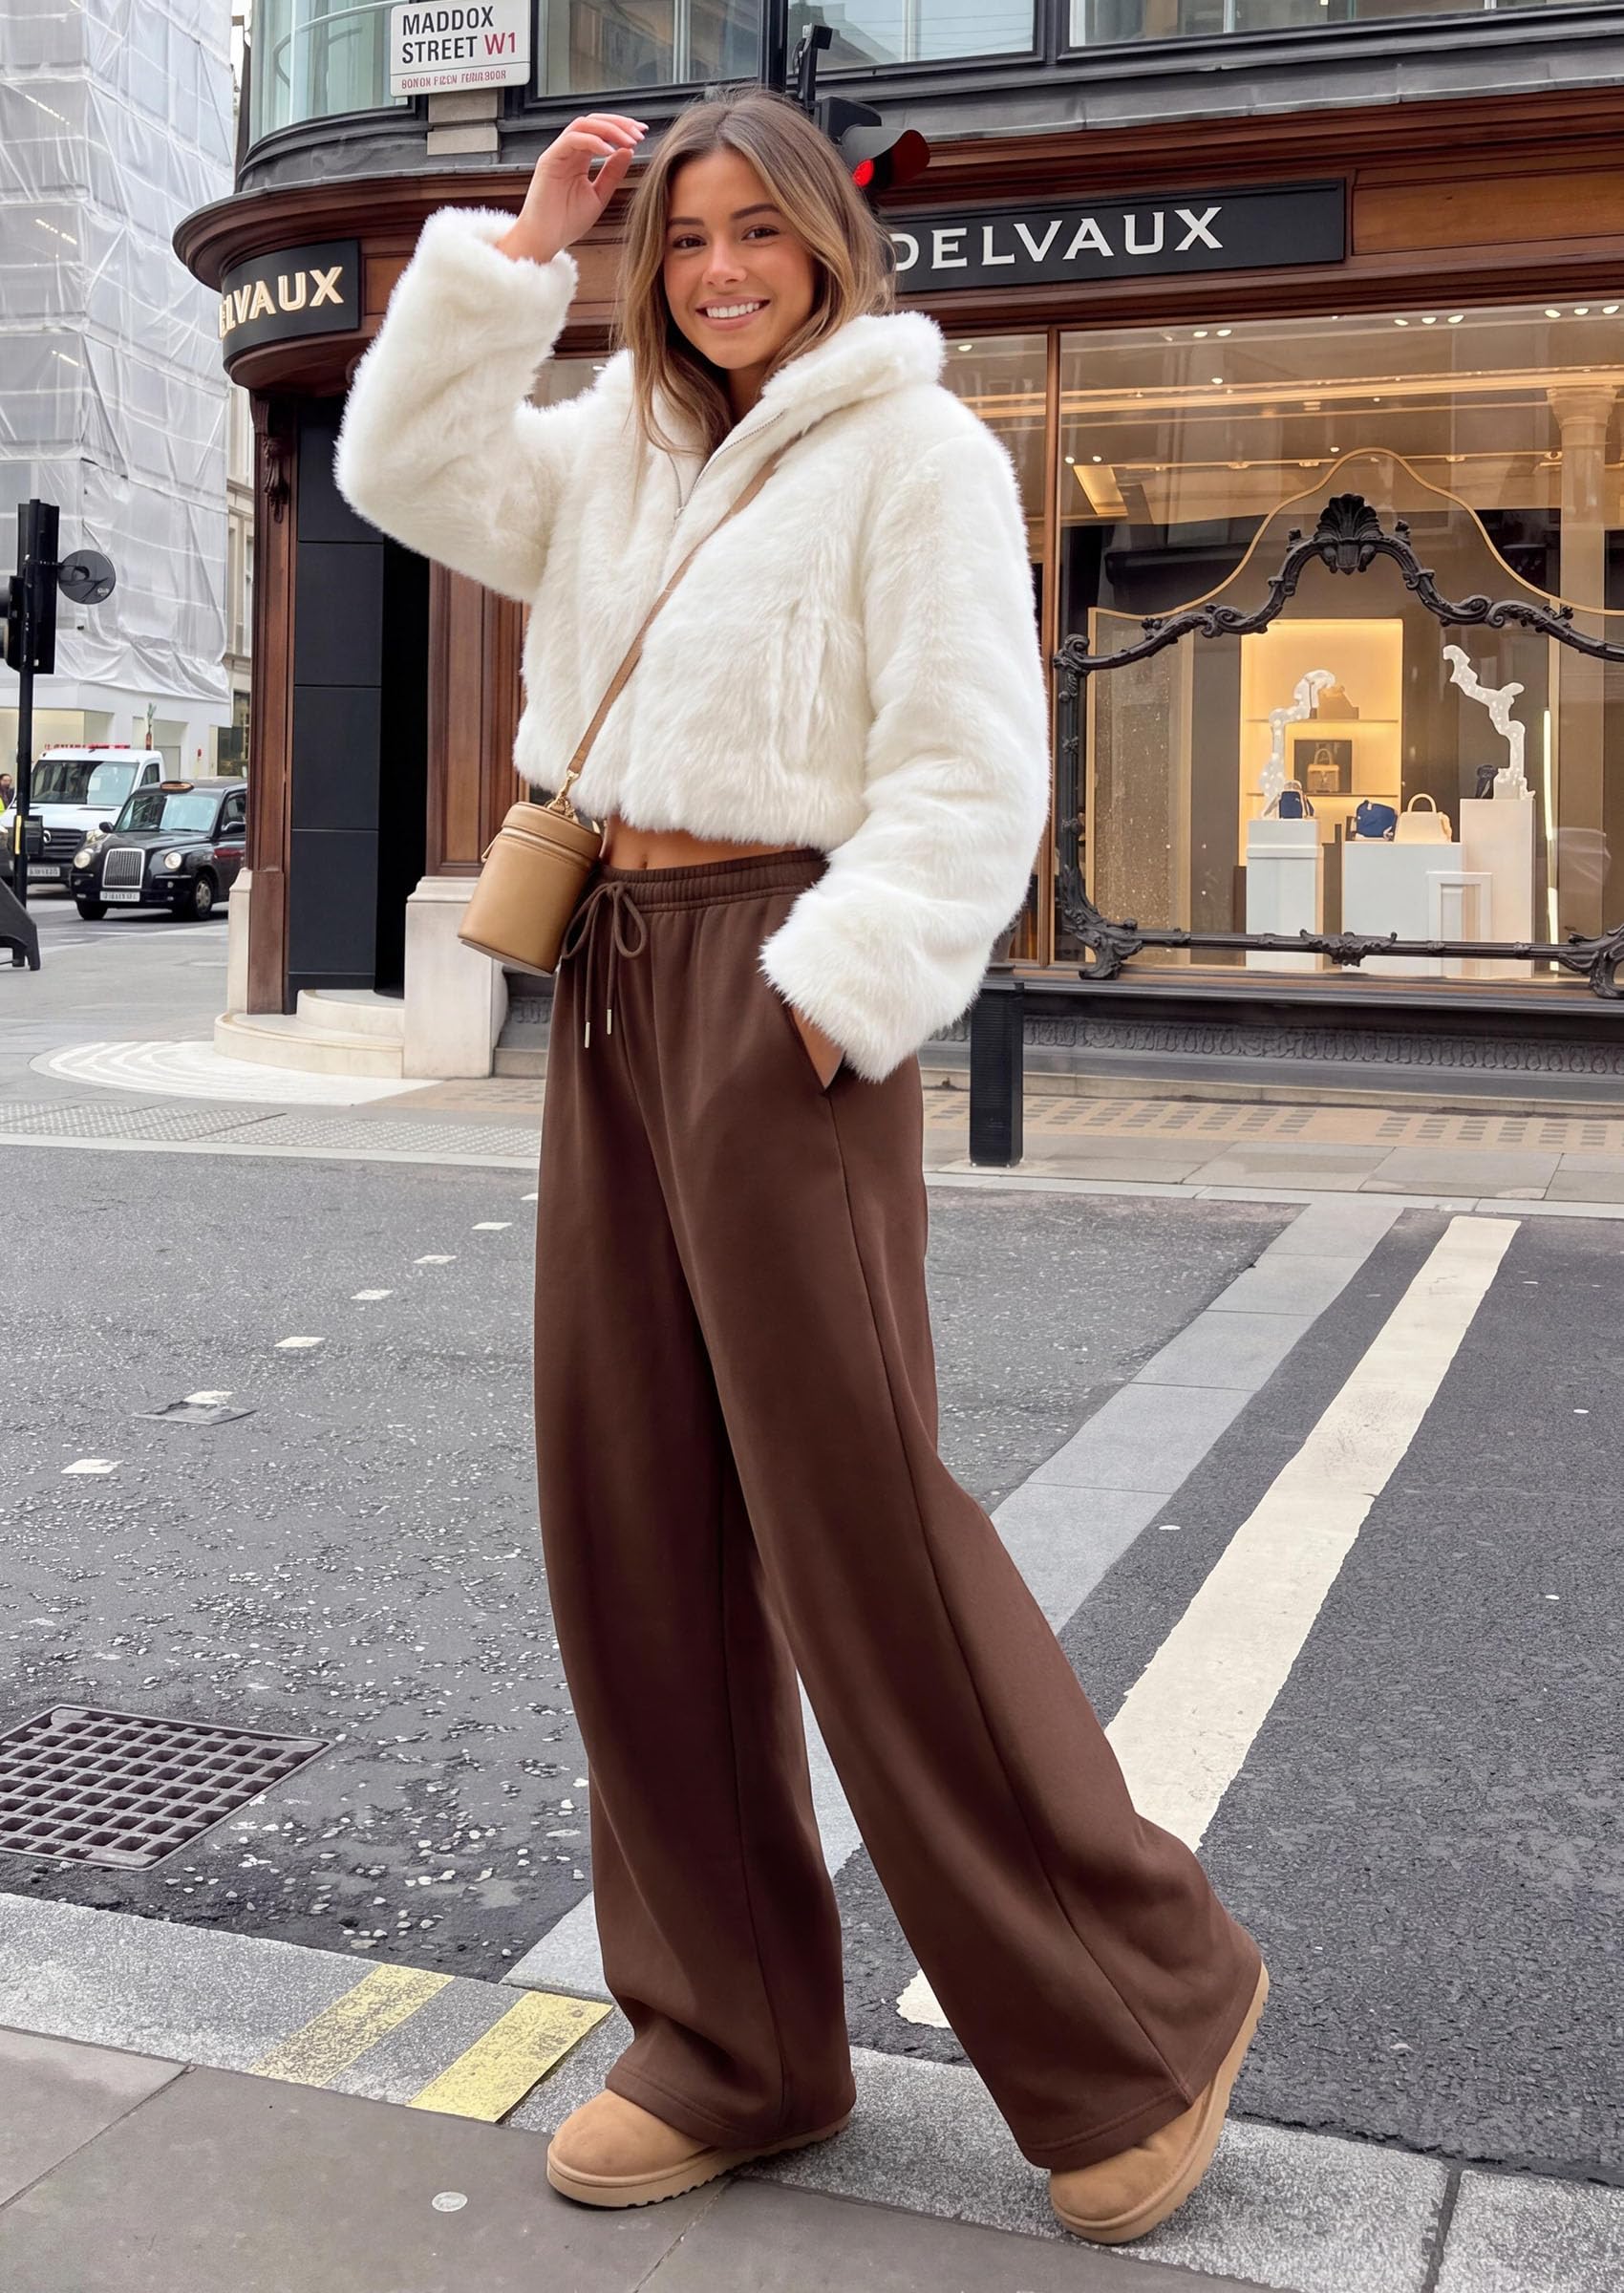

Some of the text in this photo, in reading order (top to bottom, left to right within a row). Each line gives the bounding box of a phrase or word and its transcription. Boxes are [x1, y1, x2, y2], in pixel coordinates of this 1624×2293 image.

[402, 6, 494, 35] MADDOX
[401, 32, 516, 64] STREET W1
[888, 206, 1224, 271] DELVAUX
